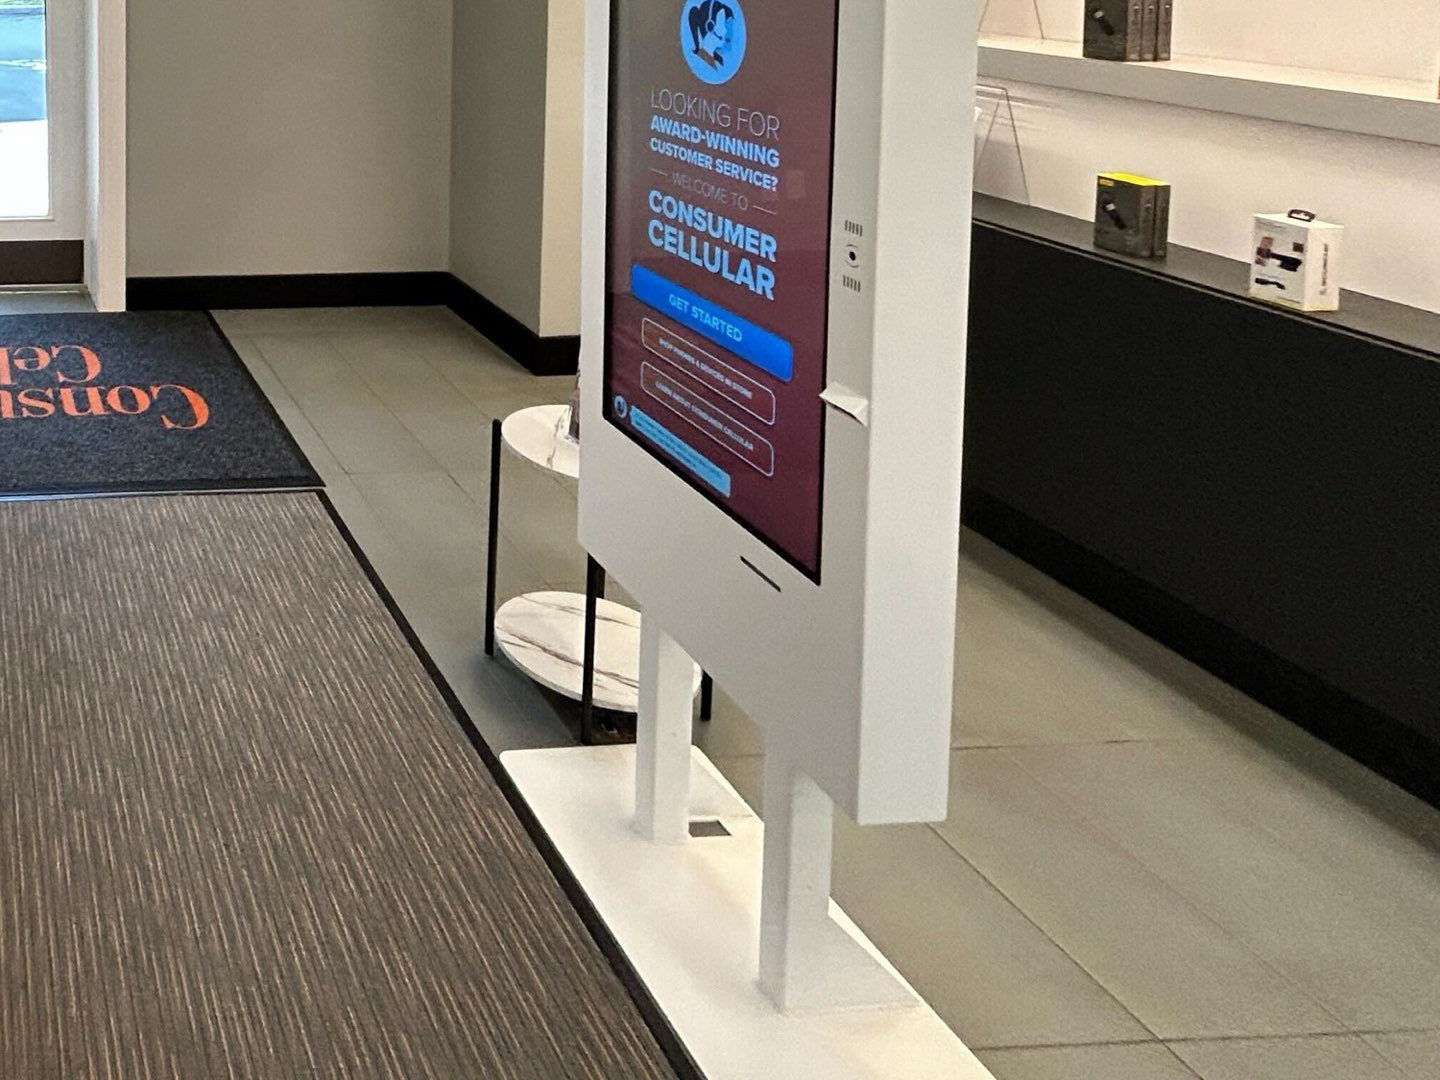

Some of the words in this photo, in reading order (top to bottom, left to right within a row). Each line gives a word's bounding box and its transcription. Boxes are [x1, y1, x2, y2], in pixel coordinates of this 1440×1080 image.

[651, 89, 731, 127] LOOKING
[737, 108, 780, 140] FOR
[650, 115, 780, 168] AWARD-WINNING
[650, 139, 713, 171] CUSTOMER
[715, 159, 778, 191] SERVICE?
[671, 172, 727, 203] WELCOME
[729, 192, 748, 212] TO
[648, 189, 777, 263] CONSUMER
[647, 219, 776, 301] CELLULAR
[669, 293, 689, 316] GET
[691, 305, 743, 343] STARTED
